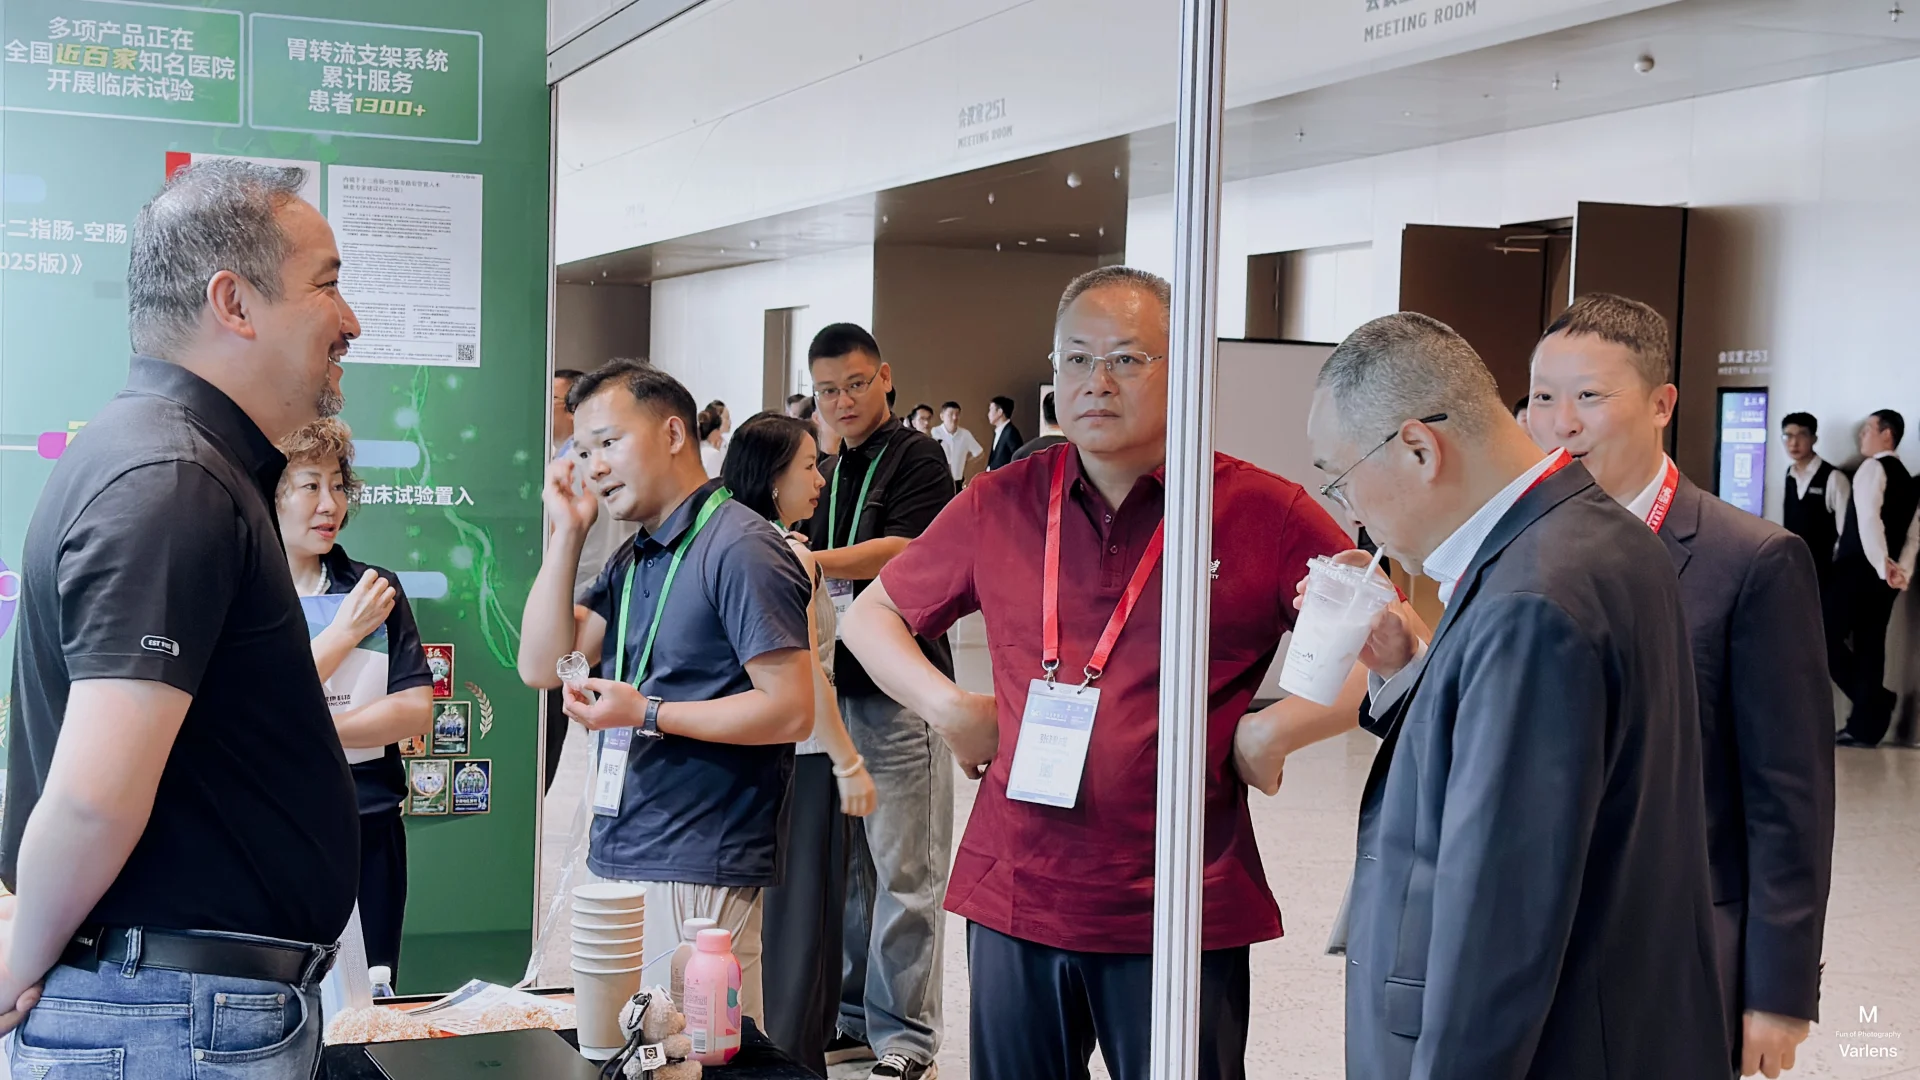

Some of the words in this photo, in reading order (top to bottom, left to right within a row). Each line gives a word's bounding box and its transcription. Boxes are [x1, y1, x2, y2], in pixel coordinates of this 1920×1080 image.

[47, 16, 195, 51] 多项产品正在
[1363, 11, 1428, 43] MEETING
[1433, 0, 1478, 25] ROOM
[4, 39, 236, 81] 全国近百家知名医院
[287, 37, 449, 73] 胃转流支架系统
[47, 68, 195, 102] 开展临床试验
[321, 65, 414, 94] 累计服务
[308, 89, 426, 117] 患者1300+
[957, 130, 989, 148] MEETING
[991, 125, 1013, 140] ROOM
